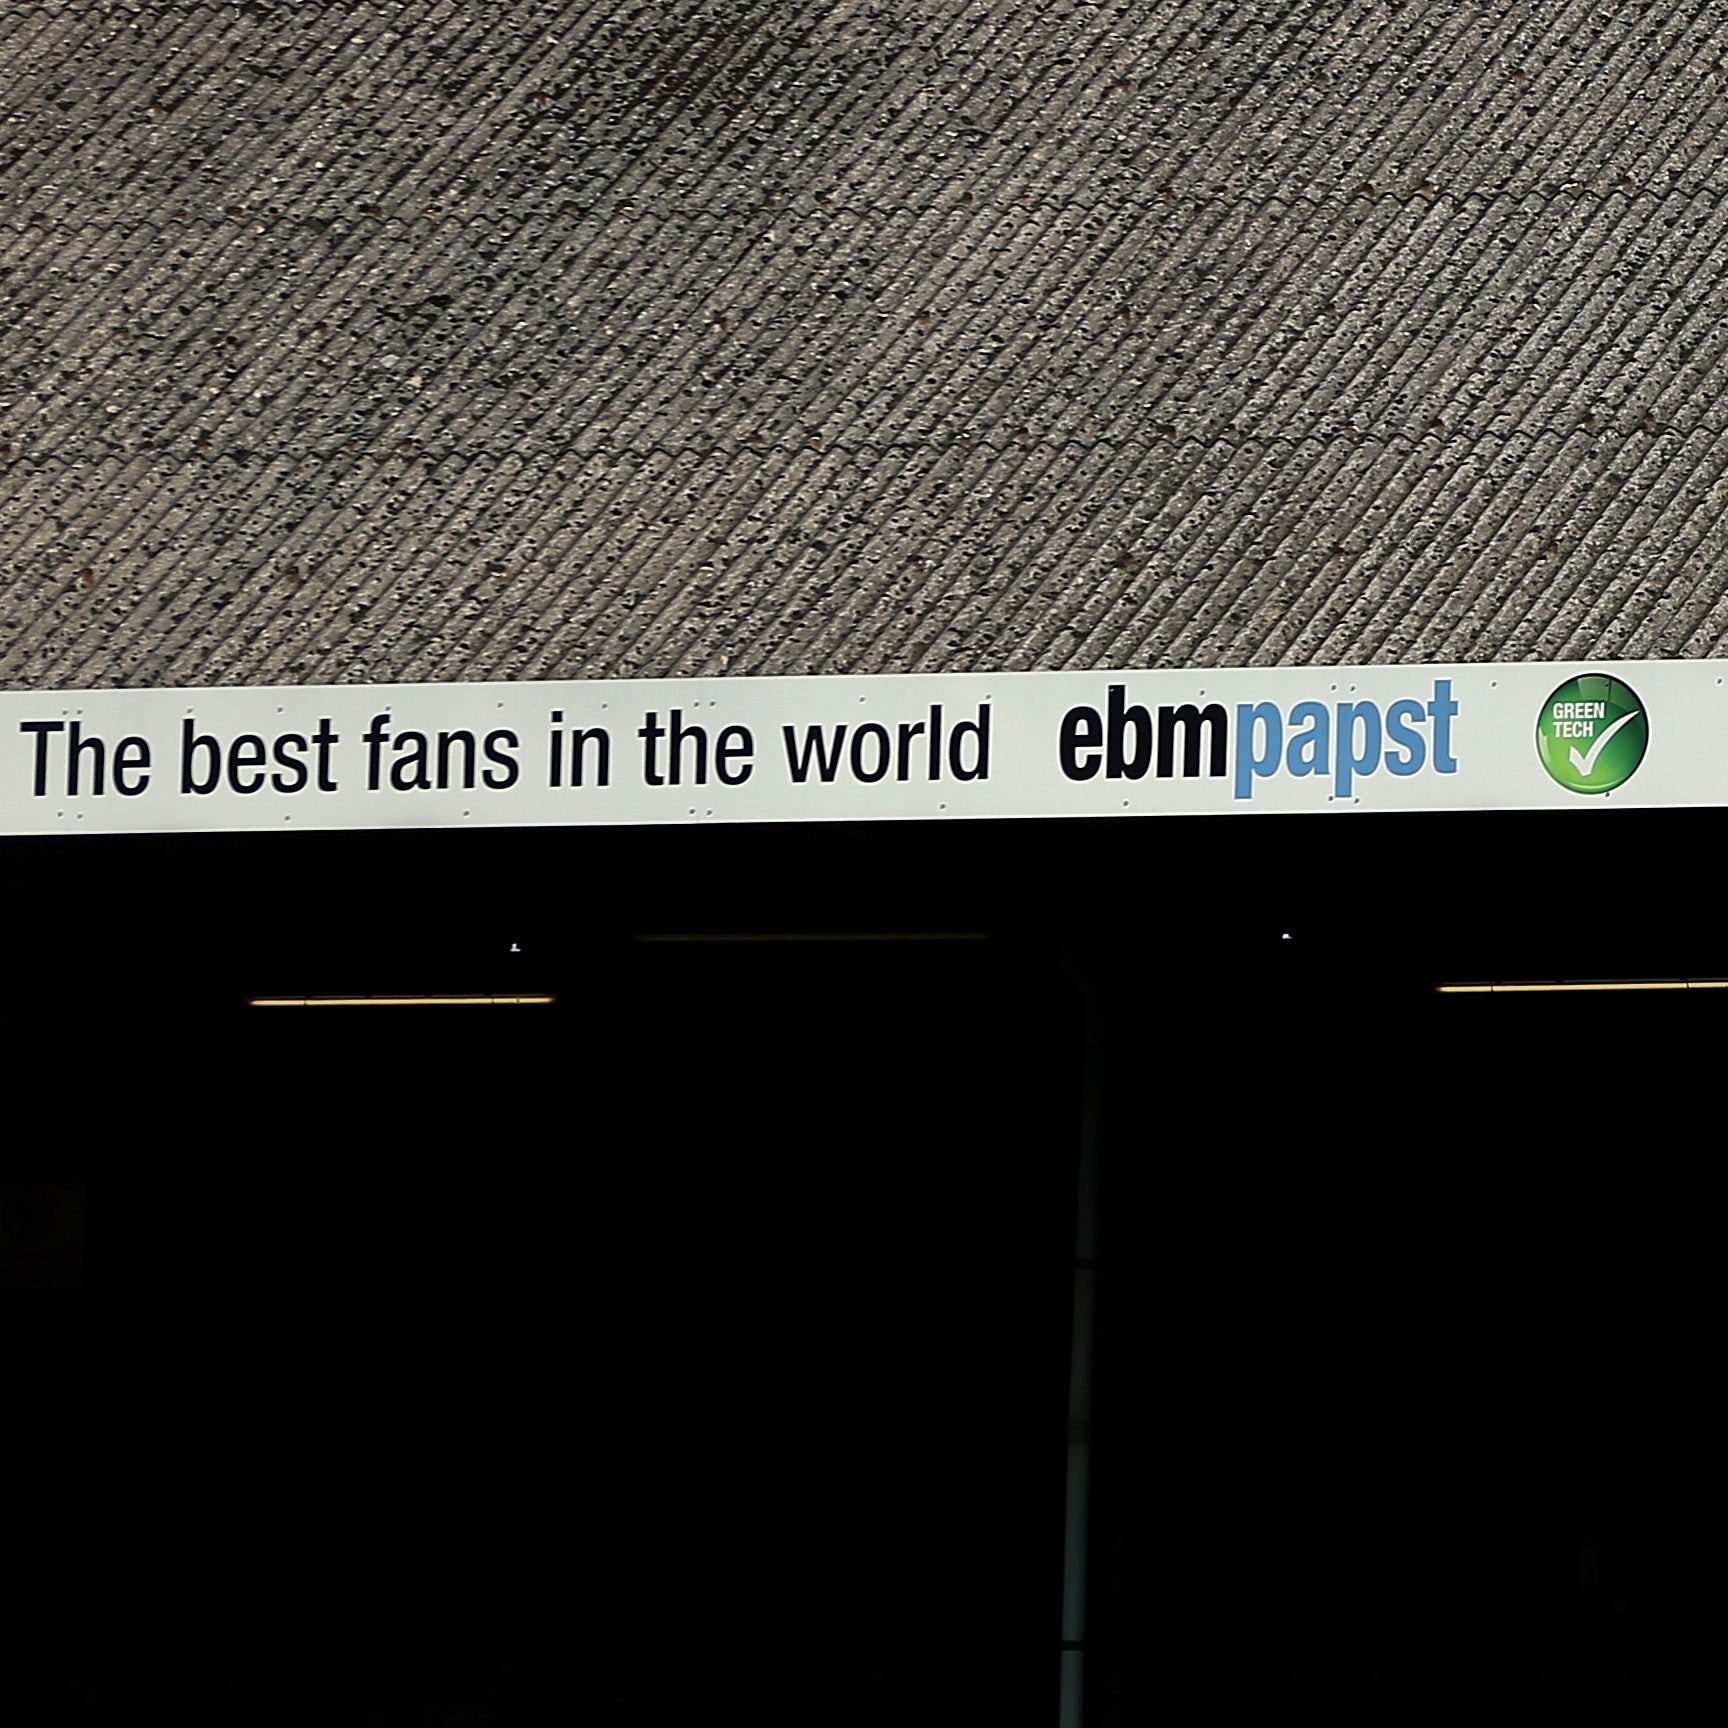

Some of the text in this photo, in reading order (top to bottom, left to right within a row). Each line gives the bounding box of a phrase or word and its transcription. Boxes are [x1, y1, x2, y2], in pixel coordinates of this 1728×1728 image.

[1553, 702, 1605, 719] GREEN
[1553, 721, 1594, 738] TECH
[20, 703, 990, 796] The best fans in the world
[1059, 679, 1458, 800] ebmpapst
